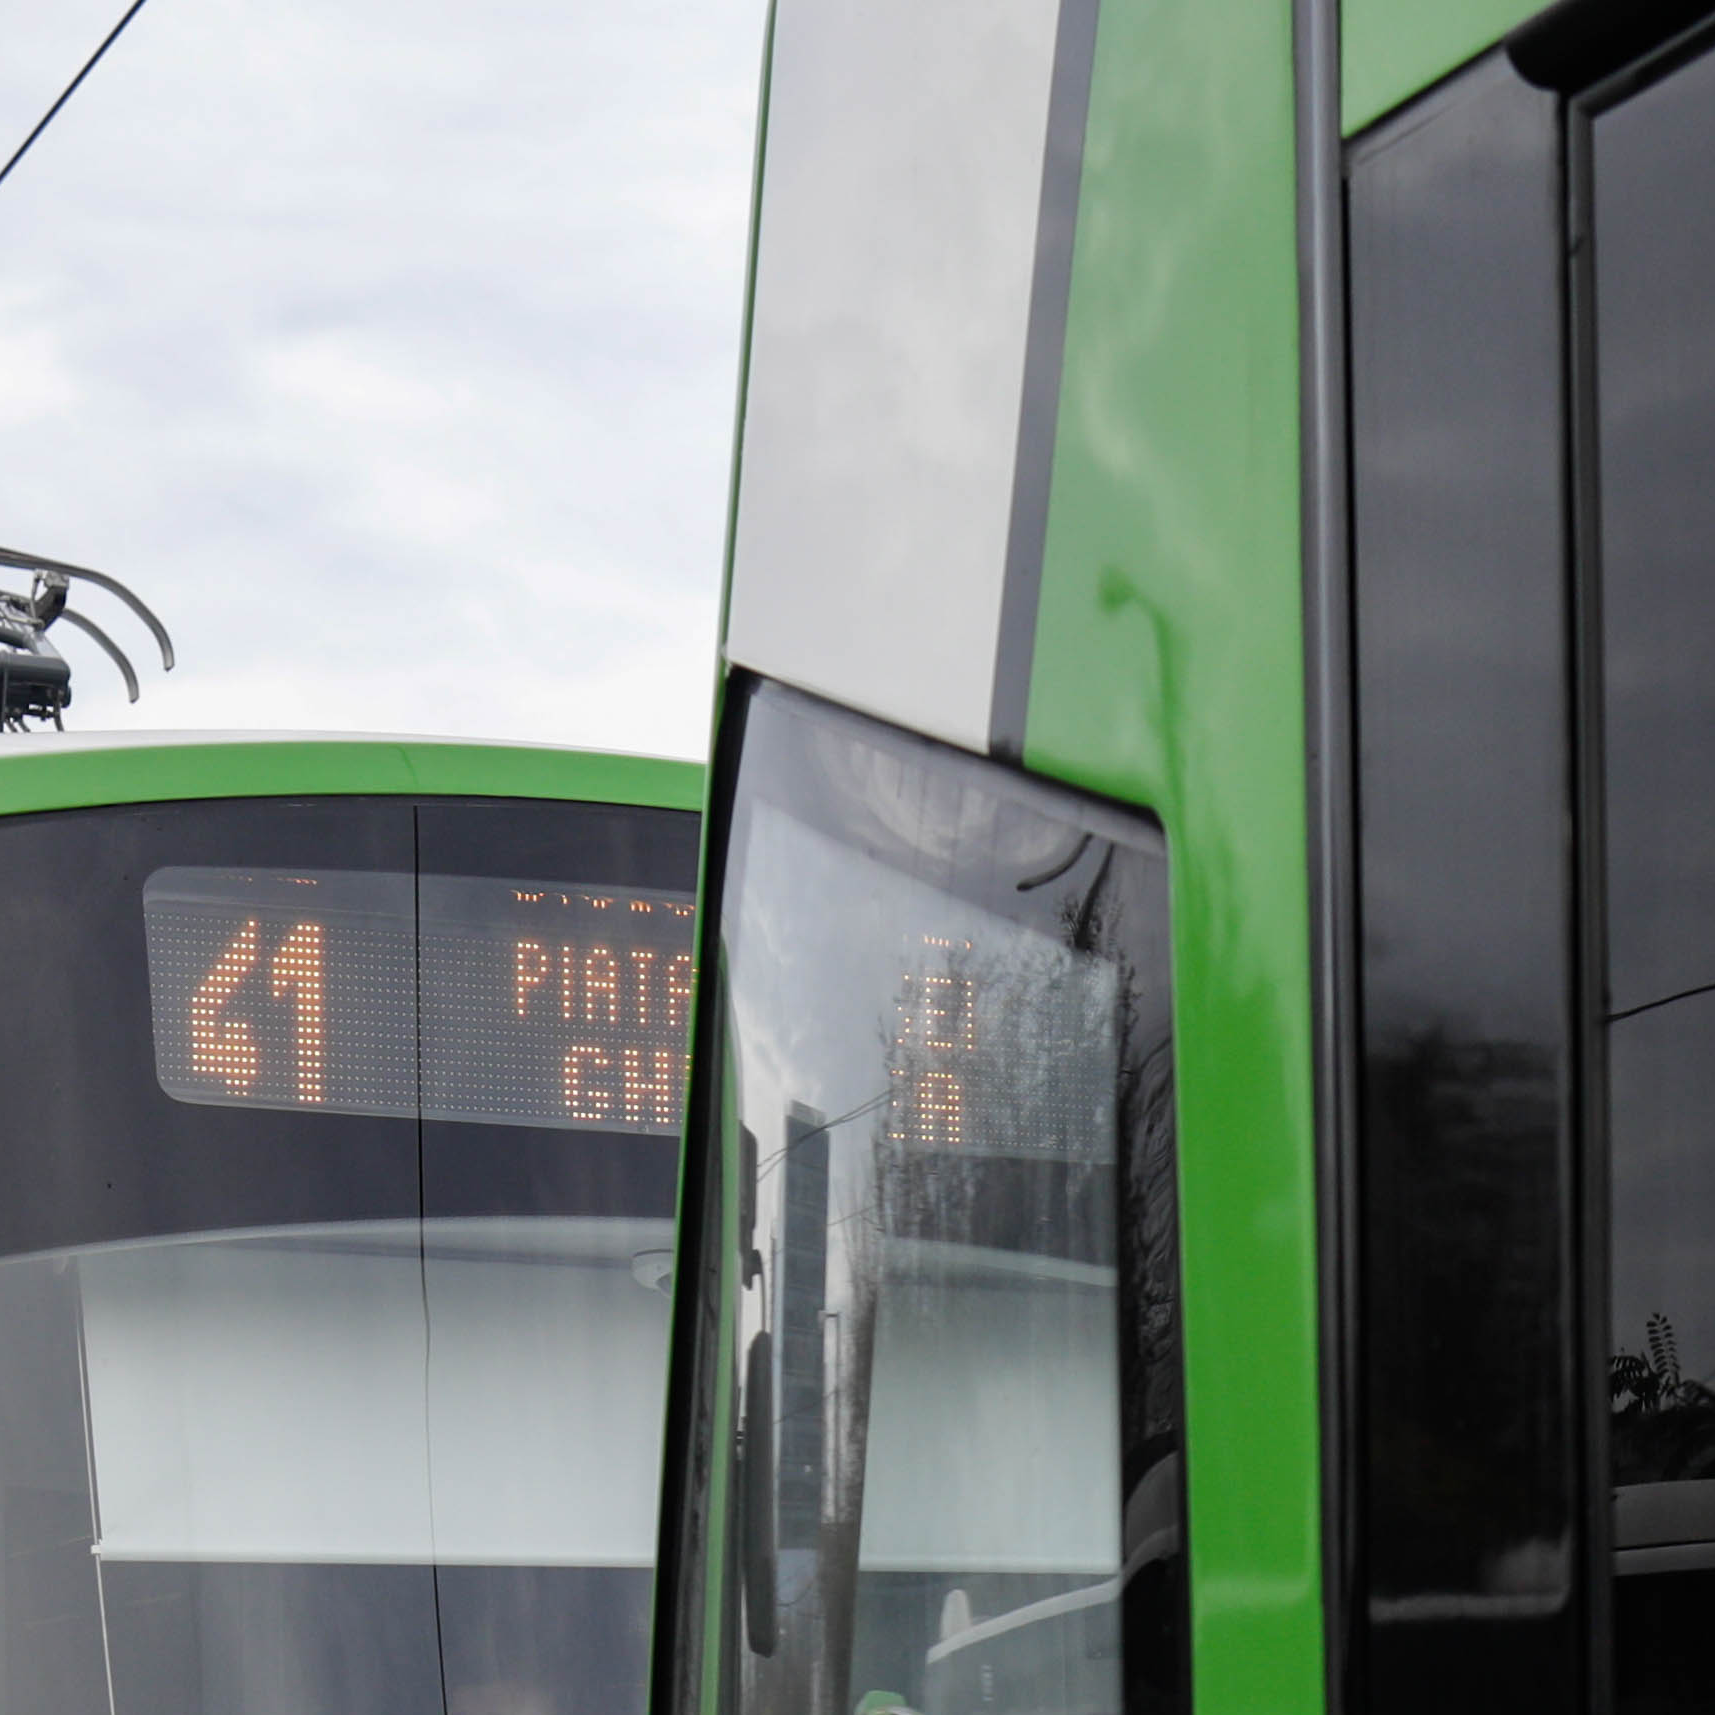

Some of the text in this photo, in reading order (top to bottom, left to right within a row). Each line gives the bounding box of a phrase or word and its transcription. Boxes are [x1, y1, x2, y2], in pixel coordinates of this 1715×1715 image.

[190, 917, 322, 1101] 41
[517, 941, 698, 1025] PIATA
[564, 1046, 691, 1123] GH
